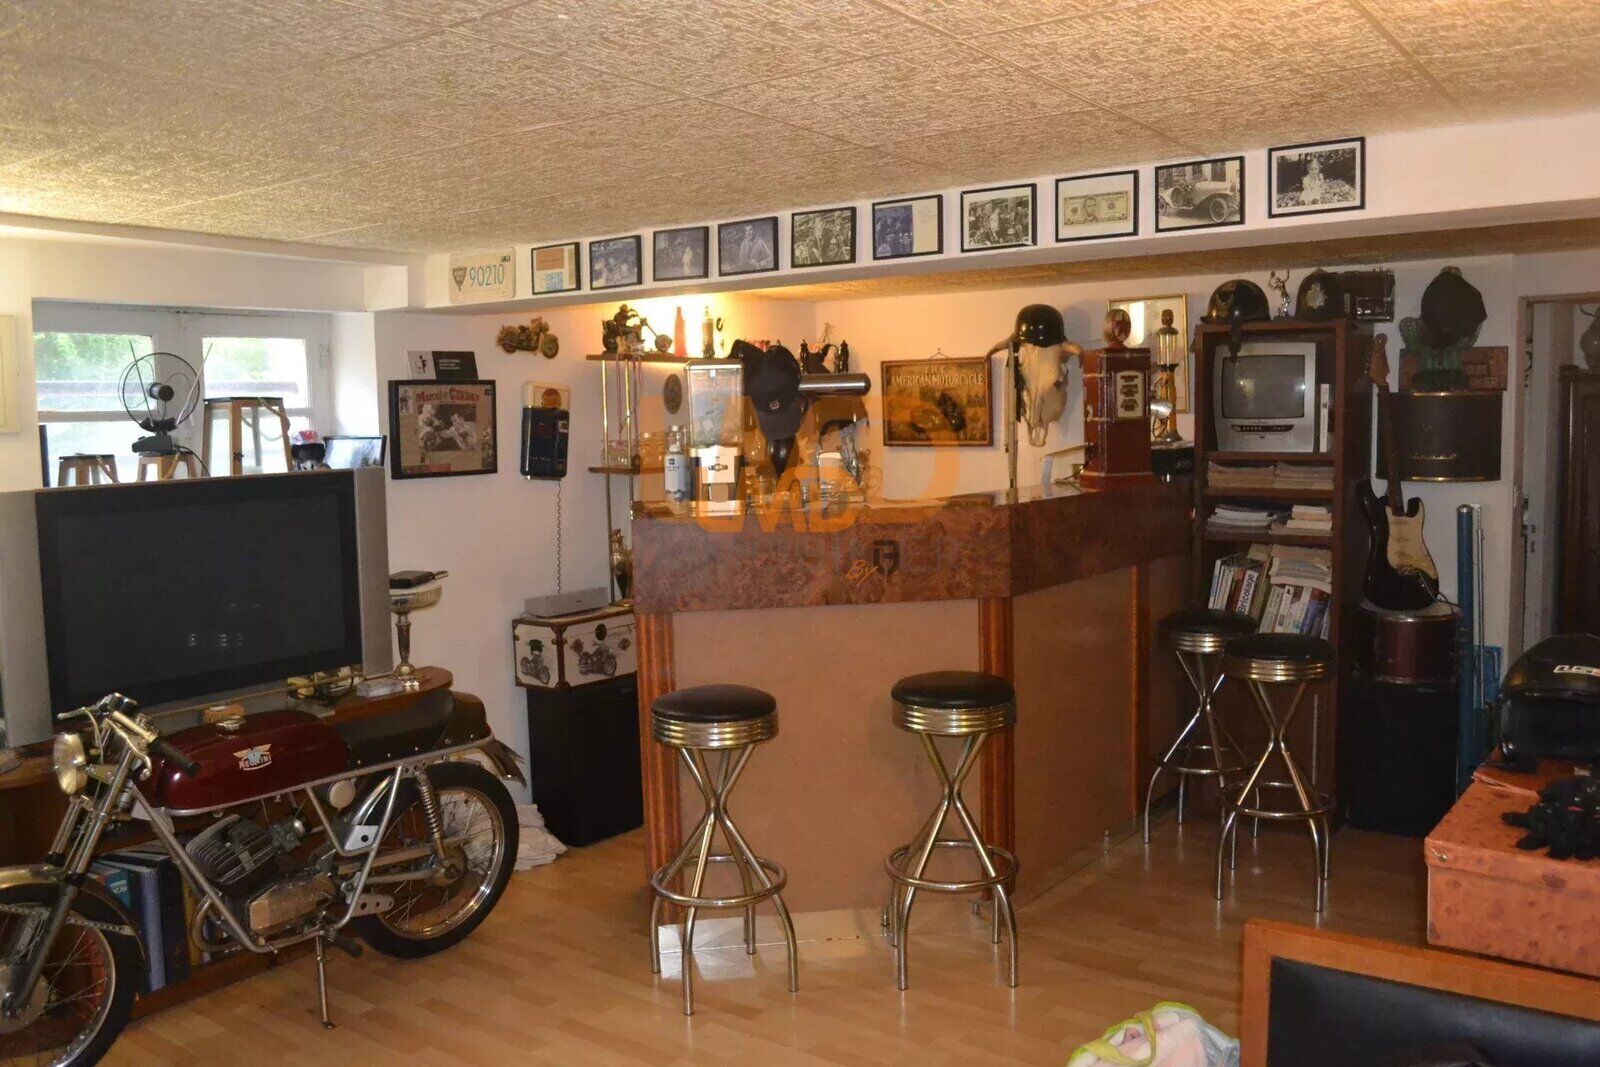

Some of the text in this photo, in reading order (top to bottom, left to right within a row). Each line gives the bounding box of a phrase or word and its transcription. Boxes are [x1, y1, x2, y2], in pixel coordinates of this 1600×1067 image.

[469, 263, 505, 287] 90210
[891, 374, 931, 387] AMERICAN
[1238, 573, 1255, 614] Bricolage
